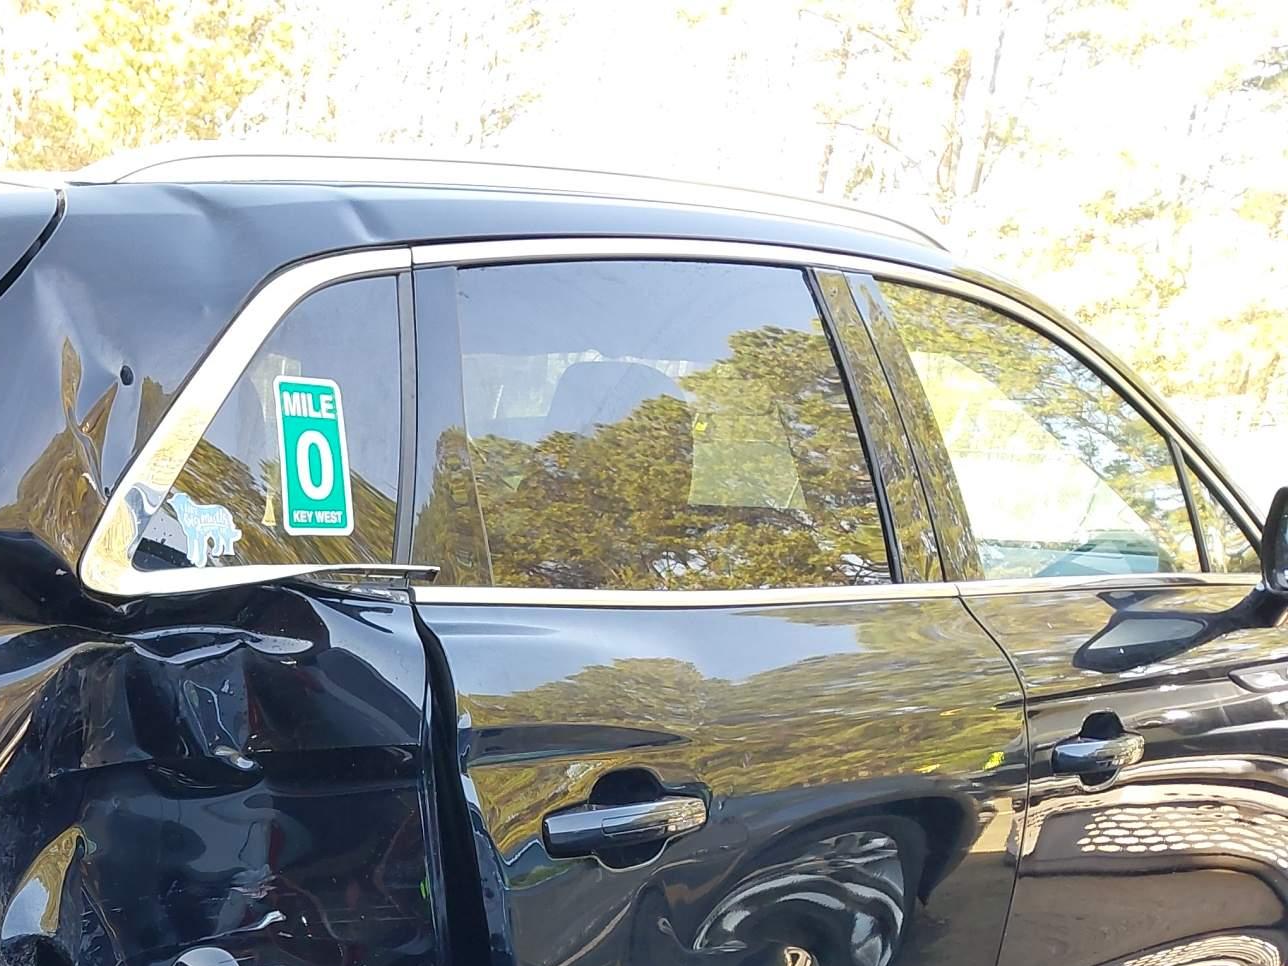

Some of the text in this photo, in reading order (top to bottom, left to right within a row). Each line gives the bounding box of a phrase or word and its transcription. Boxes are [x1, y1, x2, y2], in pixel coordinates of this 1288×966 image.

[282, 391, 337, 419] MILE
[296, 430, 334, 500] 0
[293, 509, 343, 524] KEY WEST
